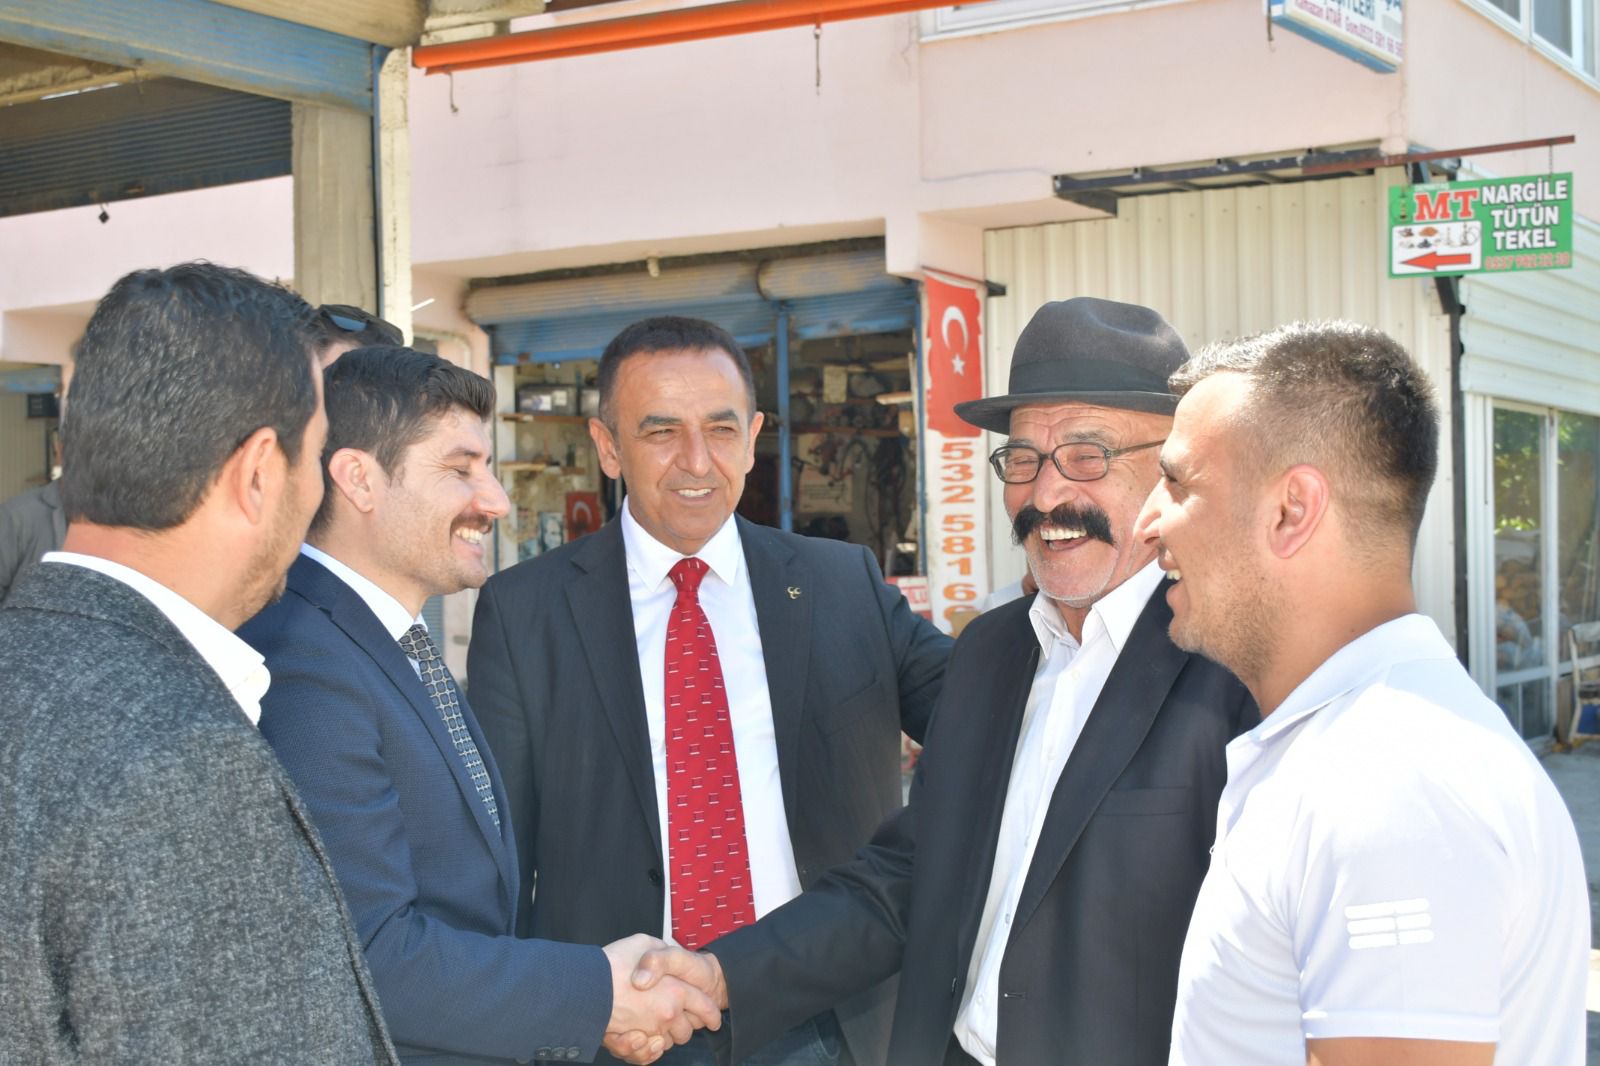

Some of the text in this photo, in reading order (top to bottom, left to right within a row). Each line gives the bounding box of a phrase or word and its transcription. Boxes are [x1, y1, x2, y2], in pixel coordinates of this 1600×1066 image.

[1414, 189, 1479, 221] MT
[1482, 178, 1568, 205] NARGİLE
[1491, 202, 1559, 229] TÜTÜN
[1492, 228, 1557, 250] TEKEL
